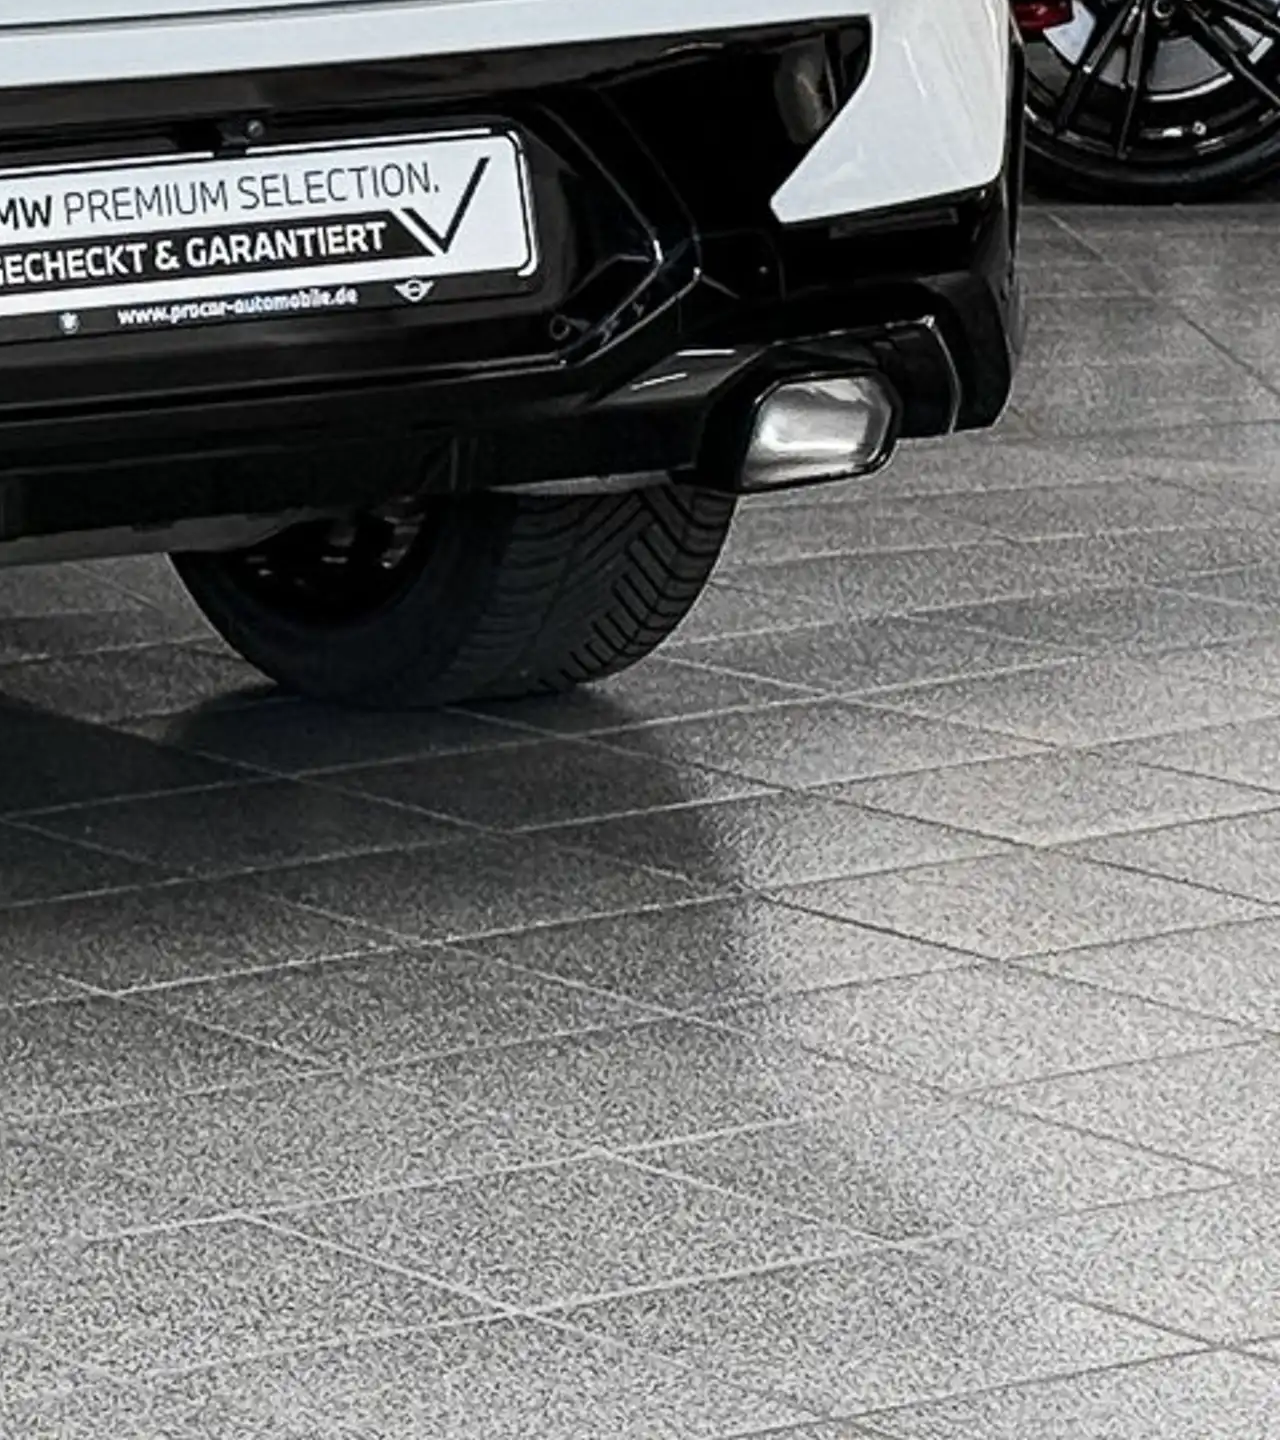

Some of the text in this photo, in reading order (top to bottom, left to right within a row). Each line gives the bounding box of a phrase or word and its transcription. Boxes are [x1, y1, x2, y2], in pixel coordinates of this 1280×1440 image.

[63, 179, 228, 226] PREMIUM
[237, 161, 440, 210] SELECTION.
[154, 240, 180, 271] &
[185, 221, 387, 269] GARANTIERT
[116, 285, 359, 326] www.procar-automobile.de
